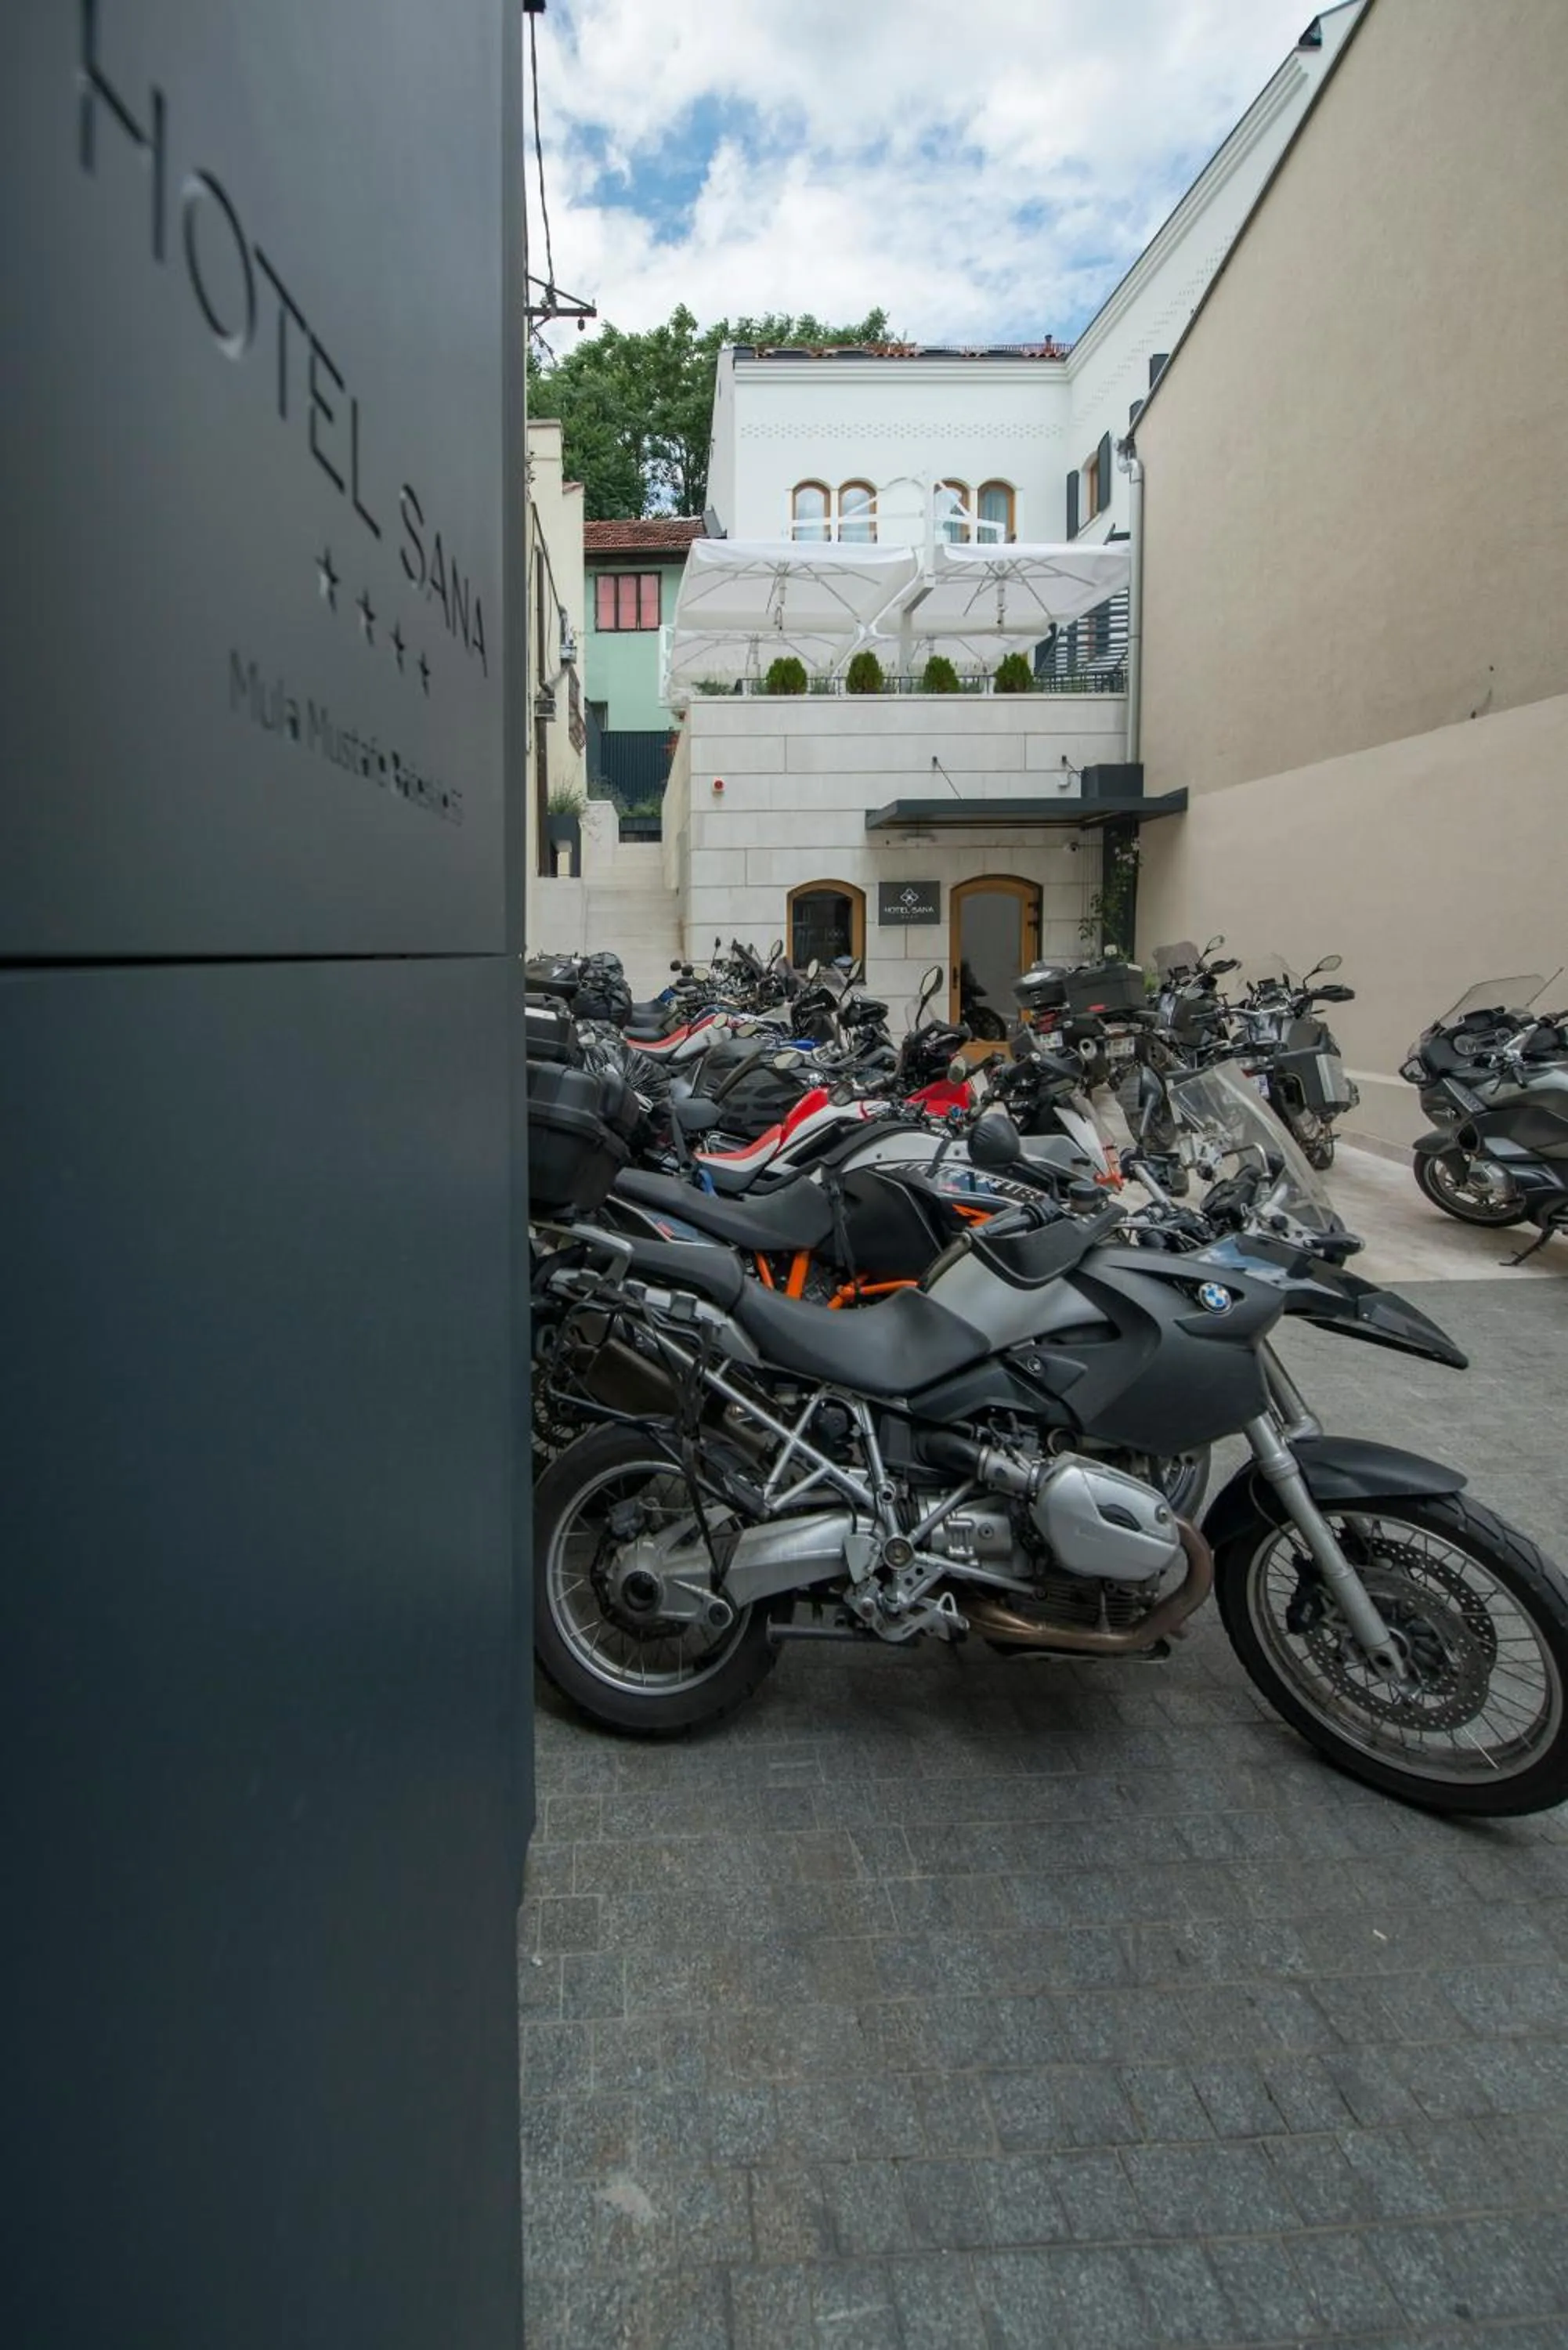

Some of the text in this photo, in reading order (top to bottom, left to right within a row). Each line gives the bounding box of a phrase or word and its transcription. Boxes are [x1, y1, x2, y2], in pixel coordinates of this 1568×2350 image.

[78, 0, 488, 678] HOTEL SANA
[883, 905, 934, 915] HOTEL SANA
